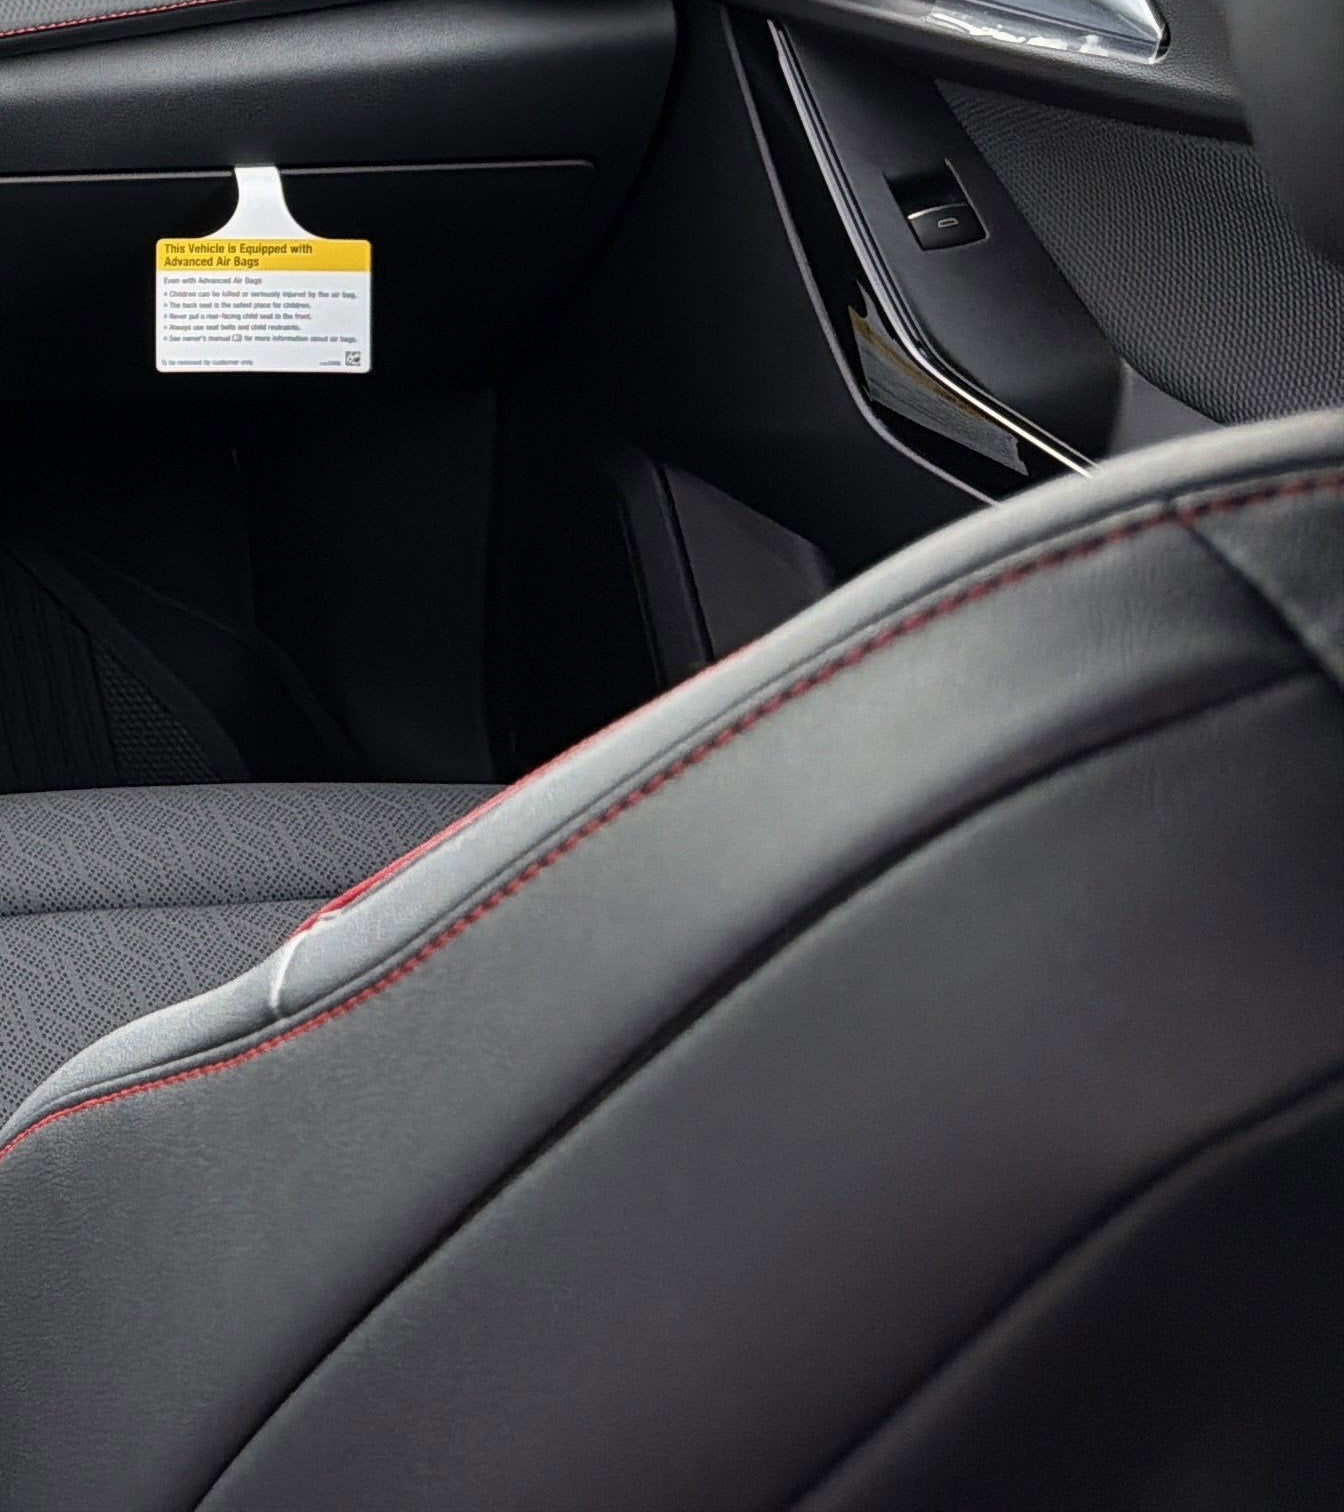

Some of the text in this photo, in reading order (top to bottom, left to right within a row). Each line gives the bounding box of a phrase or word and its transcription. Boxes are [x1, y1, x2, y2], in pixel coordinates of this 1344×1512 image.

[164, 243, 185, 254] This
[188, 243, 225, 254] Vehicle
[240, 243, 287, 256] Equipped
[290, 243, 313, 254] with
[164, 256, 259, 268] Advanced Air Bags
[245, 277, 262, 285] Bags
